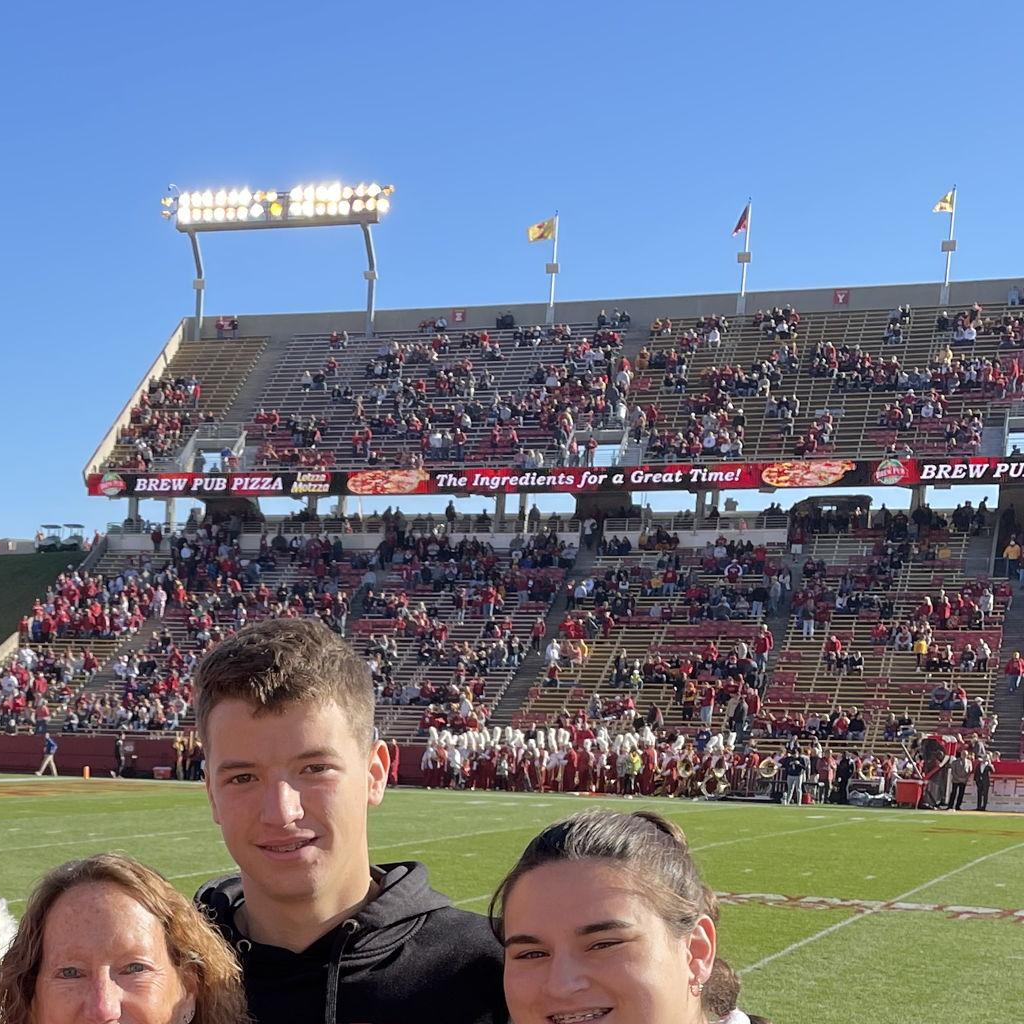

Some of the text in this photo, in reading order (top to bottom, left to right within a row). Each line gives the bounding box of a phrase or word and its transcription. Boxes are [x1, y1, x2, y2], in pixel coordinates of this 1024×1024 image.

[436, 468, 743, 490] The Ingredients for a Great Time!
[920, 464, 990, 479] BREW
[992, 462, 1024, 478] PU
[134, 477, 188, 492] BREW
[190, 477, 227, 491] PUB
[230, 476, 284, 491] PIZZA
